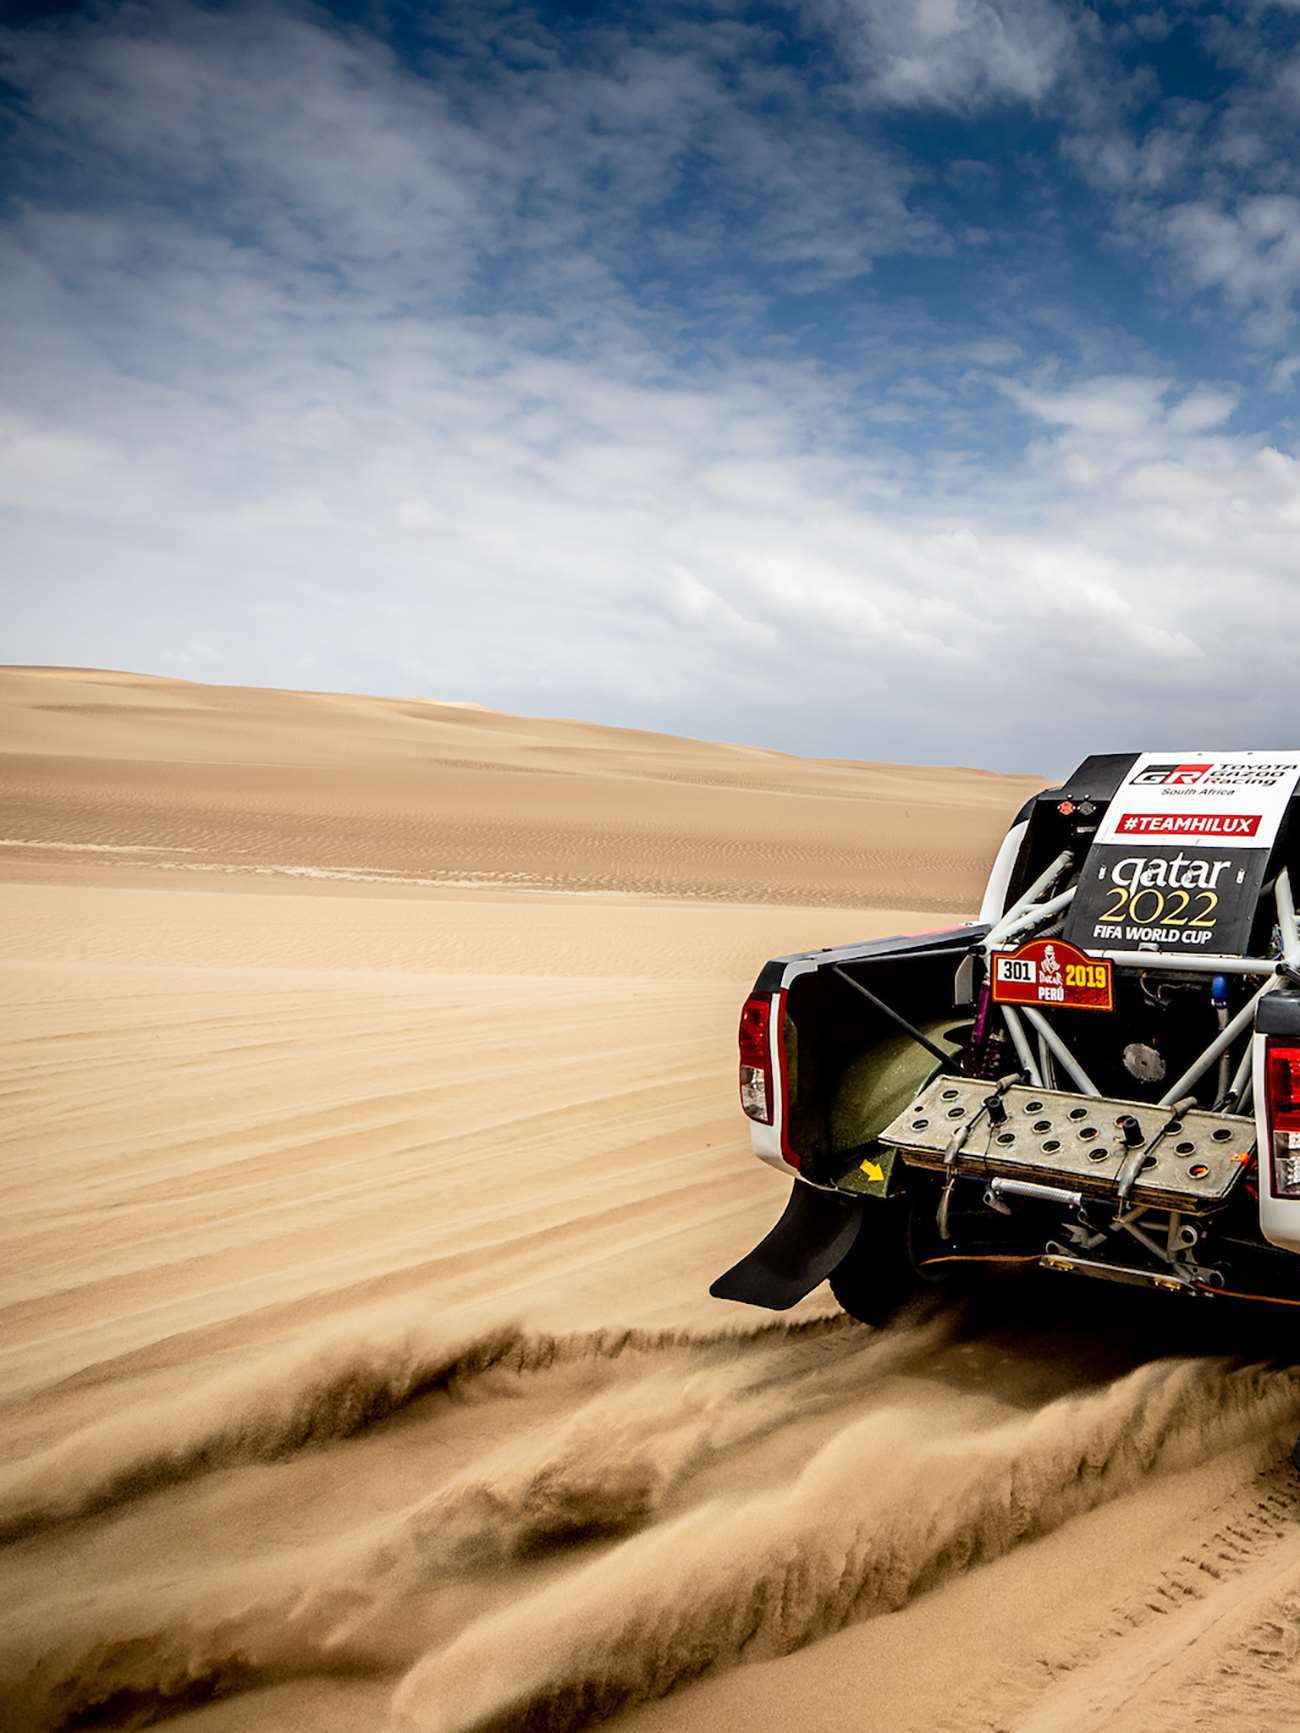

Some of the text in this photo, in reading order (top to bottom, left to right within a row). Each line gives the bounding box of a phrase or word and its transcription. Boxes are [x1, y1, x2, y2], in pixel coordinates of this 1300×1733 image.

[1209, 769, 1285, 778] GAZOO
[1218, 763, 1299, 771] TOYOTA
[1203, 777, 1278, 787] Racing
[1160, 787, 1236, 797] South Africa
[1123, 816, 1254, 833] #TEAMHILUX
[1110, 851, 1232, 900] qatar
[1098, 886, 1219, 927] 2022
[1093, 924, 1213, 945] FIFA WORLD CUP
[1003, 960, 1032, 981] 301
[1065, 964, 1106, 989] 2019
